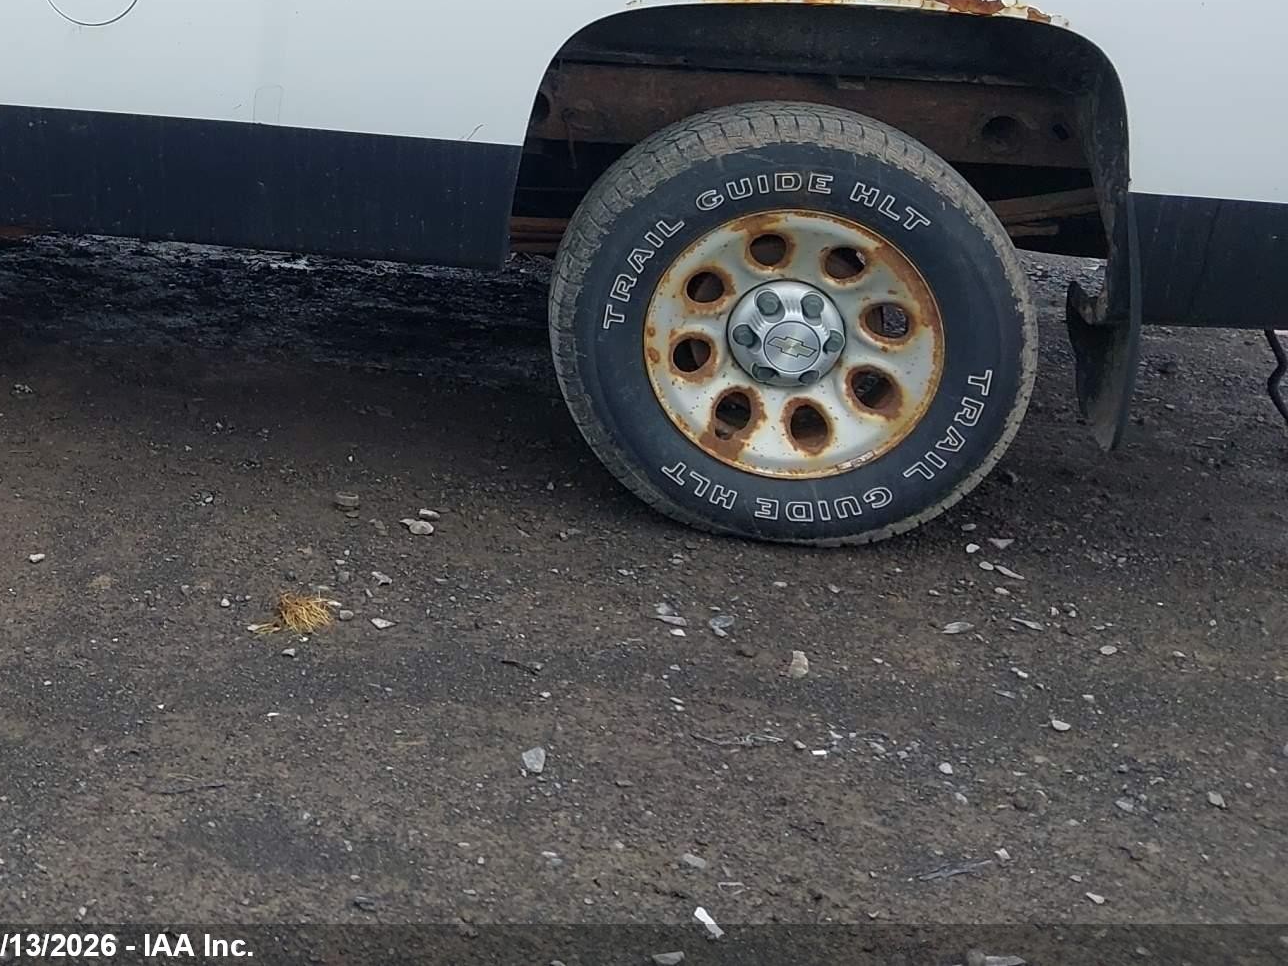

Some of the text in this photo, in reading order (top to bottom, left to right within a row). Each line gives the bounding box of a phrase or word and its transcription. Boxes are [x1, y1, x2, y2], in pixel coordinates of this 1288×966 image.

[603, 171, 931, 330] TRAIL GUIDE HLT
[661, 369, 993, 522] TRAIL GUIDE HLT
